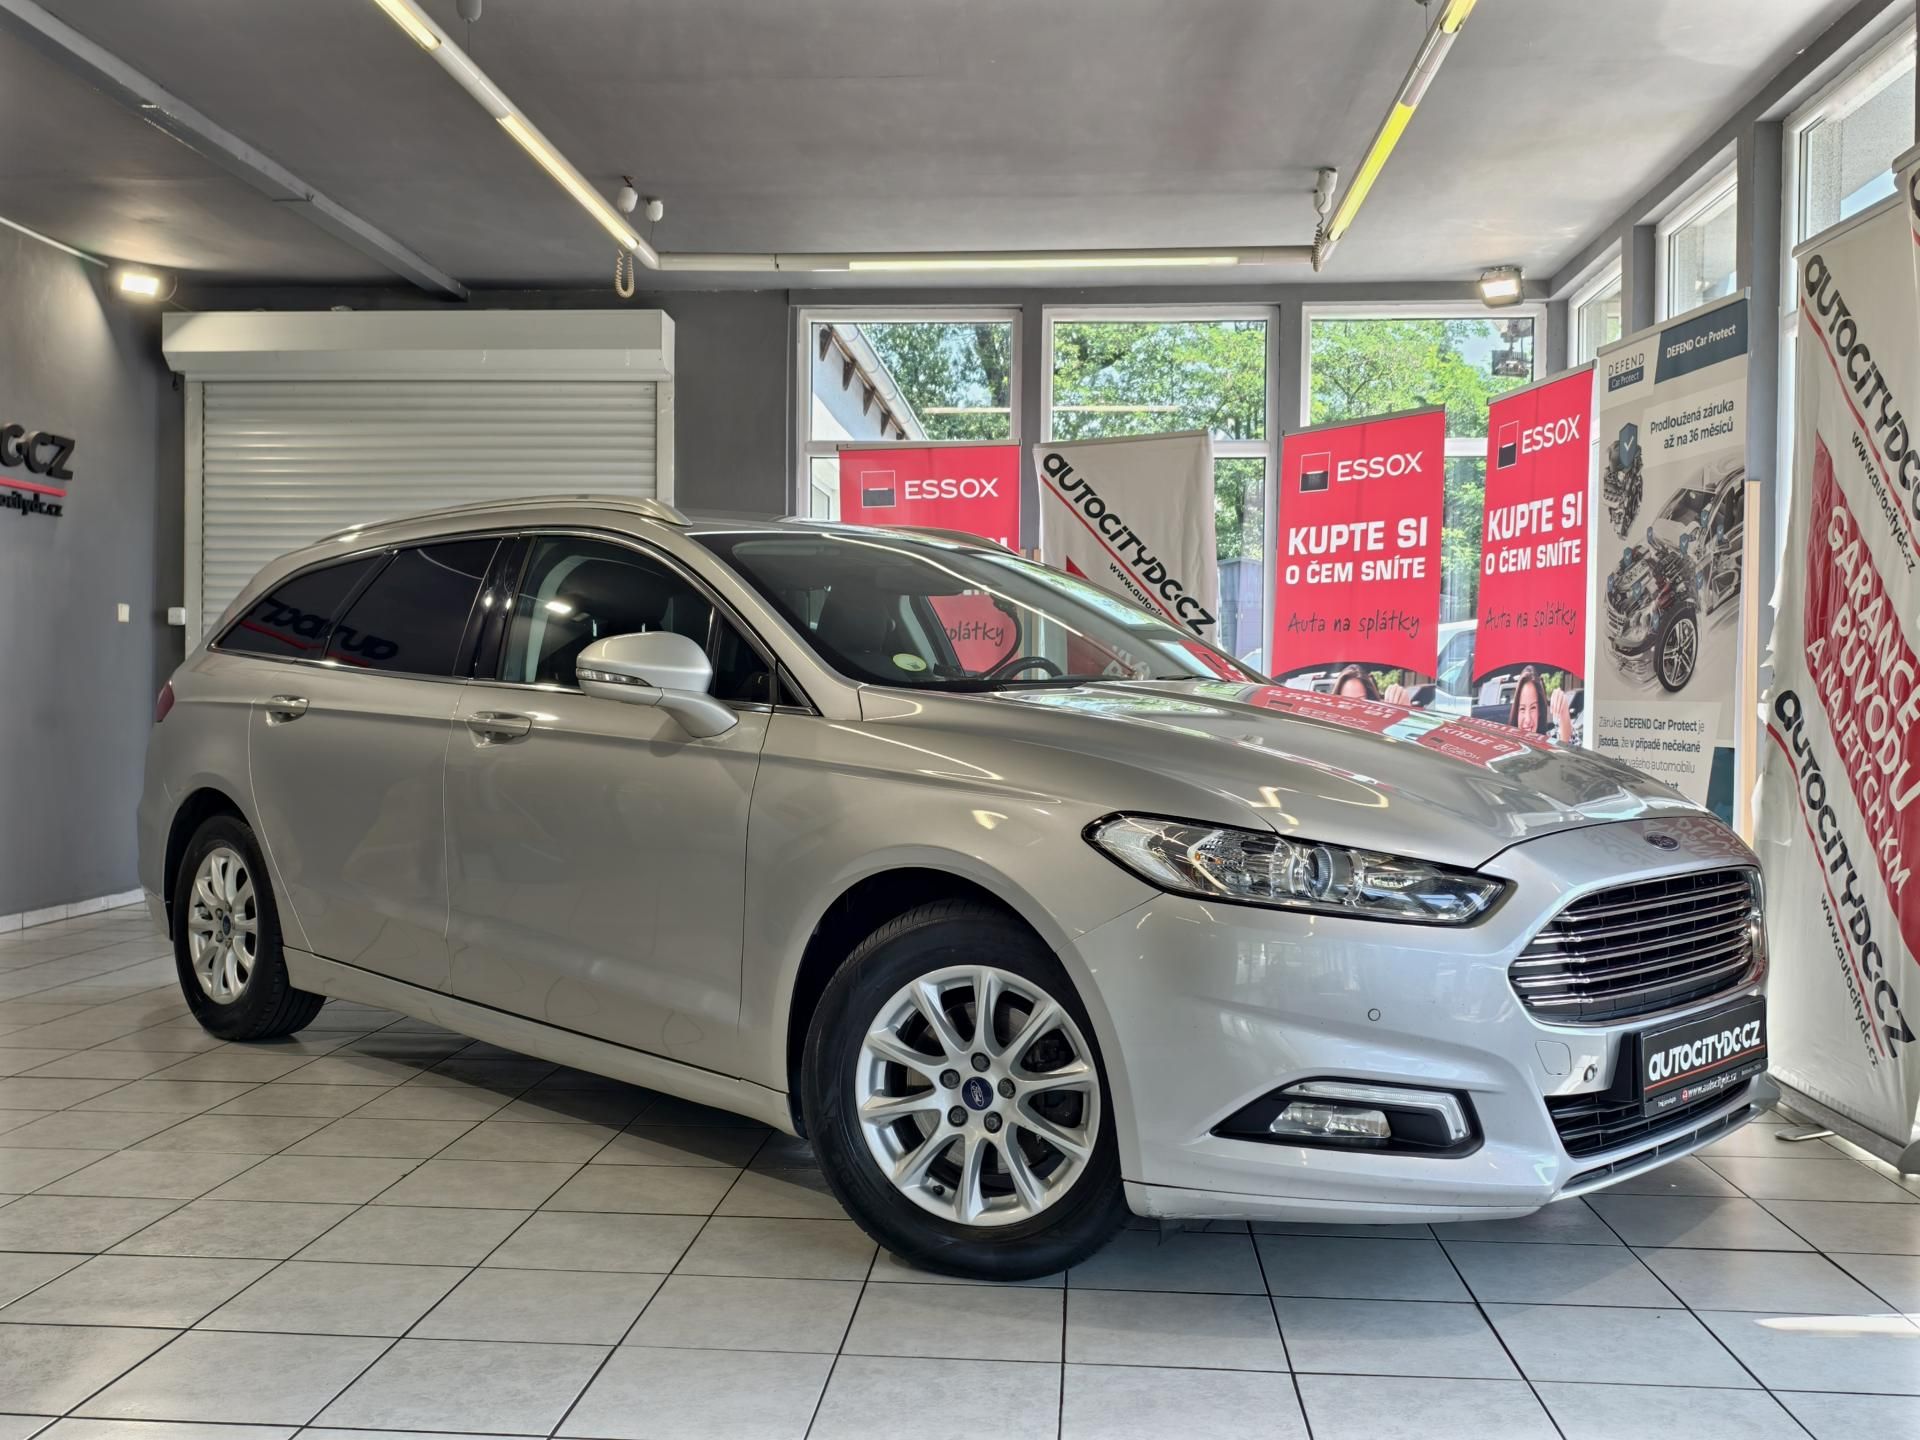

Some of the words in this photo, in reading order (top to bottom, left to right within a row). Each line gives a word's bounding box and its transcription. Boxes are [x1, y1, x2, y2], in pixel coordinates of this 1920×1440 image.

[1666, 339, 1694, 359] DEFEND
[1695, 335, 1707, 349] Car
[1708, 324, 1736, 344] Protect
[1608, 352, 1645, 377] DEFEND
[1611, 378, 1621, 388] Car
[1621, 372, 1640, 386] Protect
[1650, 406, 1701, 434] Prodloužená
[1703, 399, 1734, 419] záruka
[1664, 435, 1674, 449] až
[1676, 435, 1688, 447] na
[1689, 428, 1699, 443] 36
[1700, 416, 1734, 440] měsíců
[1521, 414, 1580, 455] ESSOX
[1337, 451, 1423, 482] ESSOX
[904, 477, 1000, 500] ESSOX
[1851, 432, 1916, 574] www.autocitydc.cz
[1487, 497, 1554, 542] KUPTE
[1562, 491, 1583, 528] SI
[1288, 520, 1385, 556] KUPTE
[1397, 516, 1429, 548] SI
[1285, 564, 1300, 585] O
[1306, 559, 1353, 584] ČEM
[1361, 555, 1426, 580] SNÍTE
[1485, 552, 1495, 576] O
[1499, 545, 1531, 575] ČEM
[1536, 537, 1581, 568] SNÍTE
[946, 620, 1005, 648] plátky
[1287, 612, 1326, 633] Auta
[1333, 616, 1350, 633] na
[1359, 609, 1420, 640] splátky
[1485, 609, 1512, 629] Auta
[1516, 611, 1529, 627] na
[1532, 601, 1577, 635] splátky
[1828, 506, 1920, 734] GARANCE
[1831, 603, 1920, 812] PŮVODU
[1599, 716, 1622, 729] Záruka
[1623, 718, 1652, 730] DEFEND
[1653, 719, 1666, 731] Car
[1668, 719, 1697, 732] Protect
[1698, 720, 1705, 735] je
[1621, 737, 1630, 748] že
[1635, 737, 1661, 752] případě
[1662, 738, 1701, 753] nečekané
[1807, 637, 1825, 669] A
[1821, 661, 1886, 831] NAJETÝCH
[1879, 826, 1911, 896] KM
[1821, 893, 1879, 1068] www.autocitydc.cz
